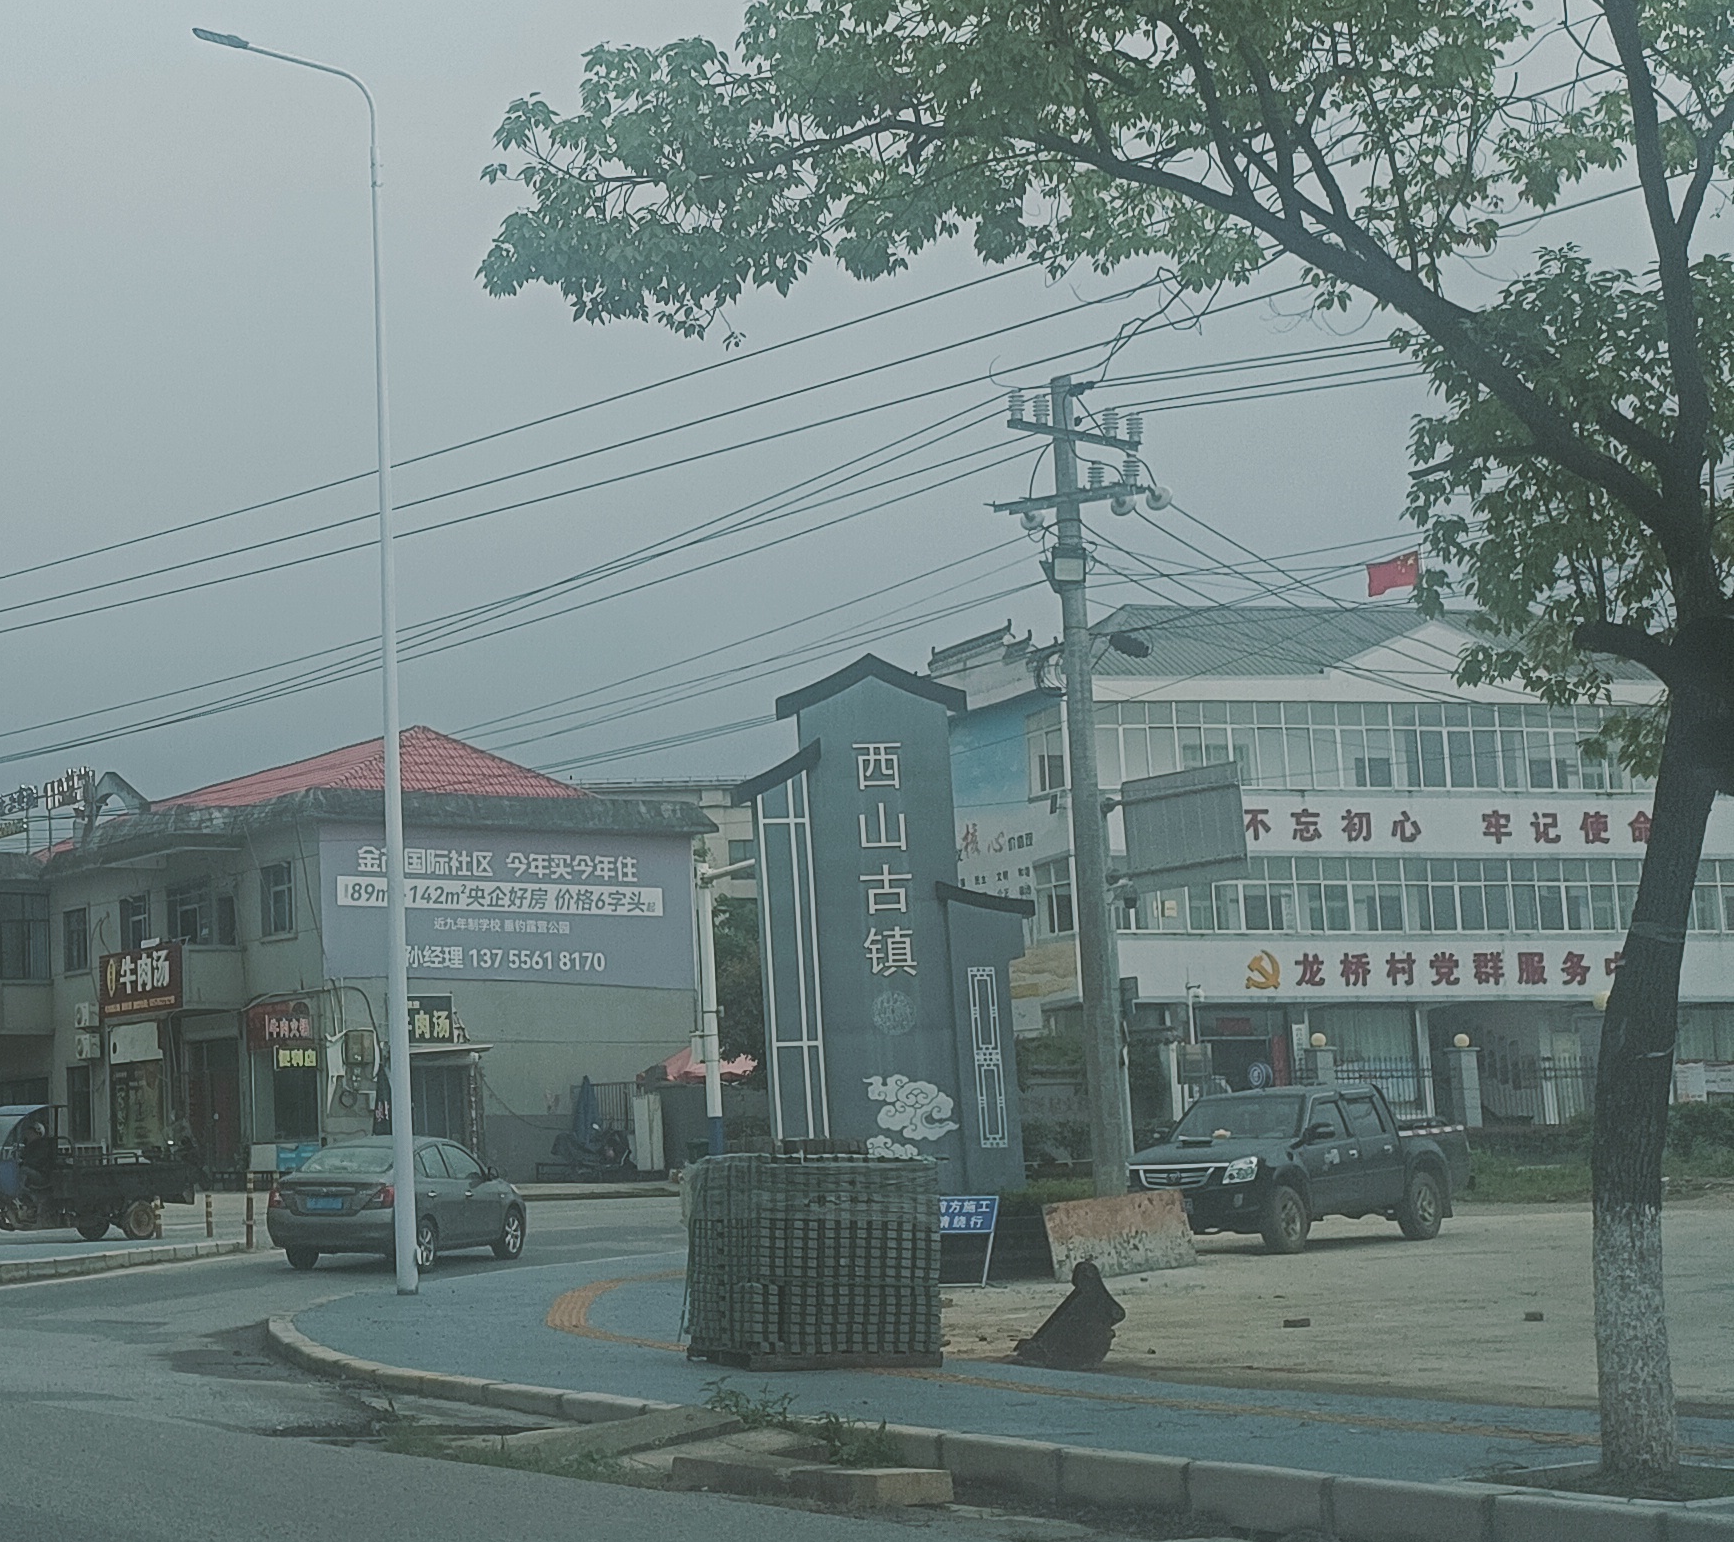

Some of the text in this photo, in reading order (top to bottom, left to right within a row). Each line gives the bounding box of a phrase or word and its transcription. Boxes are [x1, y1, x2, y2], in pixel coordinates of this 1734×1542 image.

[1243, 808, 1653, 844] 不忘初心 牢记使命
[357, 845, 638, 883] 金国际社区 今年买今年住
[852, 742, 918, 976] 西山古镇
[349, 882, 549, 910] 89m142m²央企好房
[433, 917, 502, 933] 近九年制学校
[119, 949, 170, 994] 牛肉汤
[468, 948, 503, 969] 137
[508, 950, 554, 970] 5561
[559, 951, 606, 972] 8170
[407, 1010, 450, 1039] 肉汤
